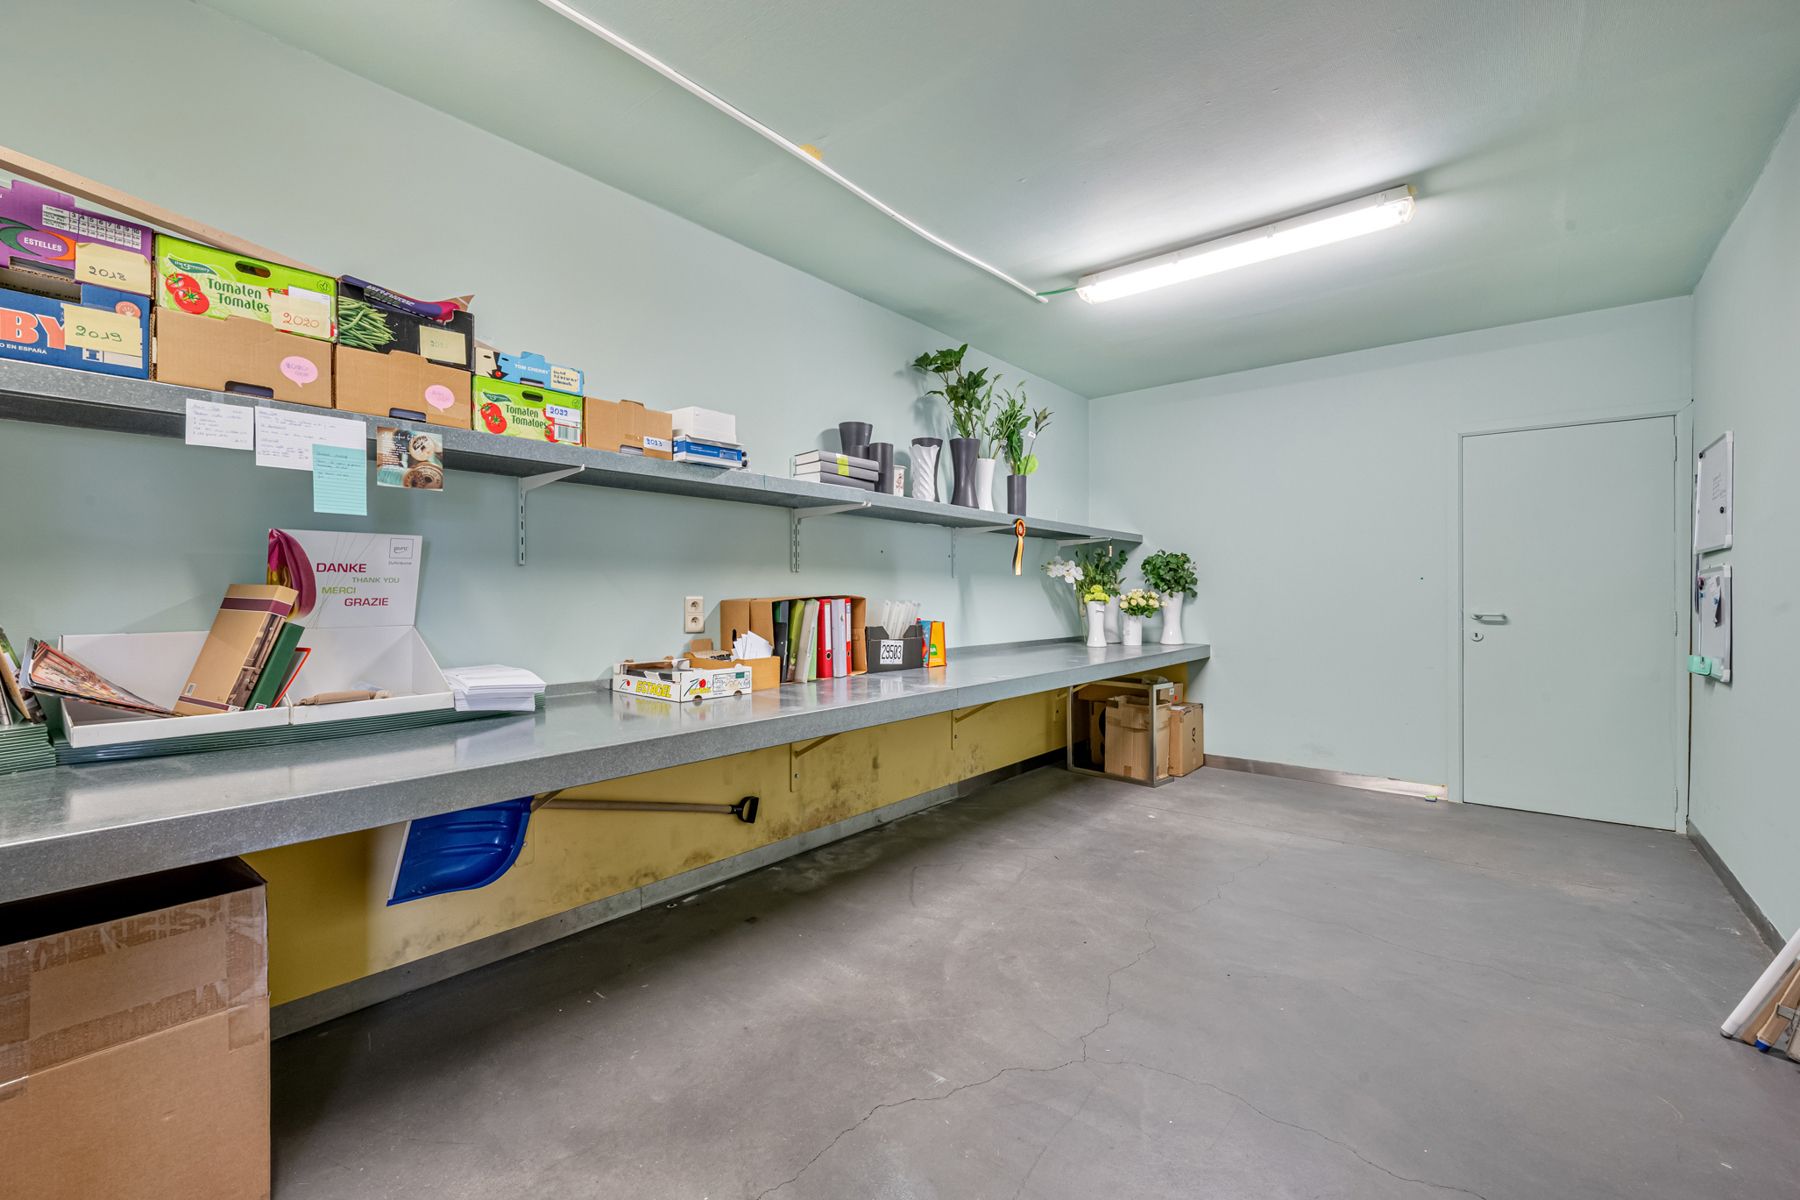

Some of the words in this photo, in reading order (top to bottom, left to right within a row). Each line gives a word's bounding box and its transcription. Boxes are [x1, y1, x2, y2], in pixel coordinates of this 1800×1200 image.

[24, 237, 62, 252] ESTELLES
[89, 265, 127, 281] 2018
[207, 277, 262, 300] Tomaten
[217, 292, 270, 314] Tomates
[283, 312, 320, 328] 2020
[75, 325, 122, 342] 2019
[18, 346, 48, 355] ESPAÑA
[505, 404, 539, 418] Tomaten
[512, 415, 548, 430] Tomatoes
[316, 562, 367, 573] DANKE
[321, 586, 356, 595] MERCI
[344, 597, 389, 607] GRAZIE
[635, 680, 672, 698] ESTAGEL
